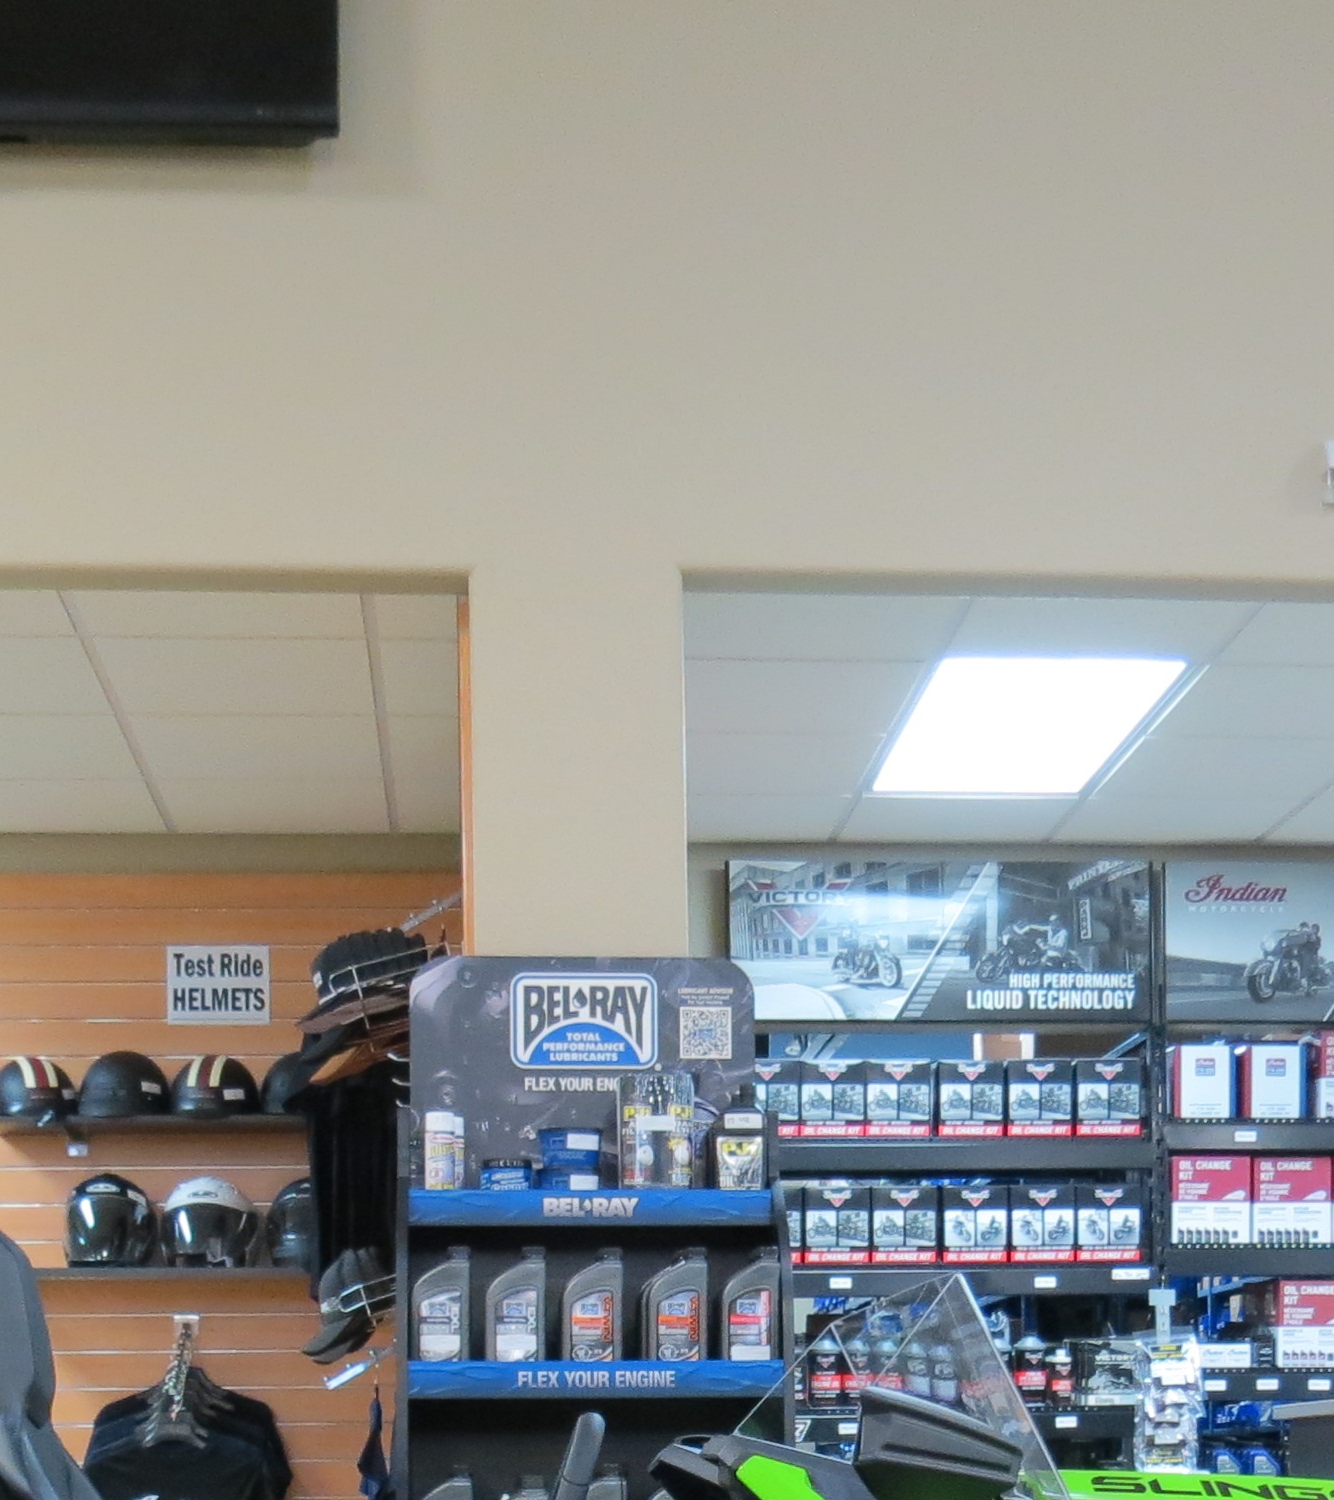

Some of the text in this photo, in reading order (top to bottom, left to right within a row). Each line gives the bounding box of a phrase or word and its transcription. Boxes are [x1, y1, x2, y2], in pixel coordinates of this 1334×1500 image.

[1184, 873, 1288, 904] Indian
[173, 953, 264, 978] Test Ride
[1009, 973, 1135, 989] HIGH PERFORMANCE
[172, 987, 266, 1012] HELMETS
[967, 990, 1136, 1011] LIQUID TECHNOLOGY
[566, 1032, 601, 1042] TOTAL
[542, 1042, 625, 1051] PERFORMANCE
[549, 1052, 618, 1062] LUBRICANTS
[524, 1077, 556, 1091] FLEX
[559, 1077, 594, 1091] YOUR
[1195, 1160, 1232, 1170] CHANGE
[1276, 1161, 1312, 1171] CHANGE
[1179, 1171, 1193, 1180] KIT
[1283, 1296, 1299, 1305] KIT
[450, 1306, 460, 1333] EXL
[527, 1306, 537, 1333] EXL
[518, 1370, 676, 1388] FLEX YOUR ENGINE
